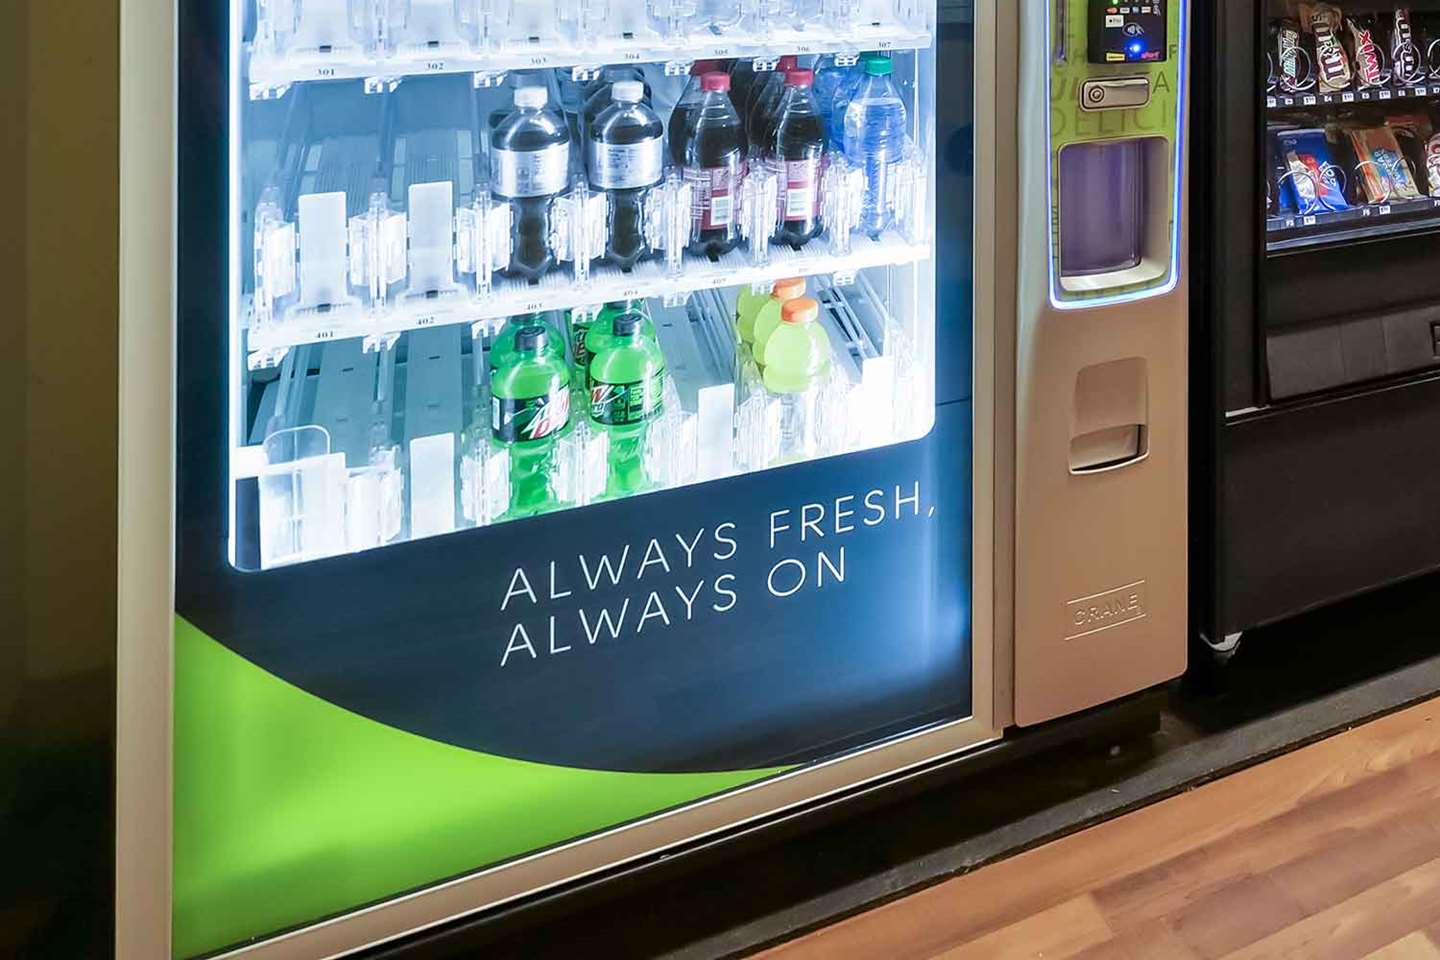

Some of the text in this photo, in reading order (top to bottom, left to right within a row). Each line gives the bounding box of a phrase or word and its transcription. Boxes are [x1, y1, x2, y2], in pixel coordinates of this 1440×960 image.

[426, 61, 444, 71] 302
[318, 68, 335, 77] 301
[416, 316, 435, 326] 402
[317, 330, 334, 339] 401
[500, 480, 935, 611] ALWAYS FRESH,
[500, 546, 847, 667] ALWAYS ON
[1074, 591, 1138, 626] CRANE
